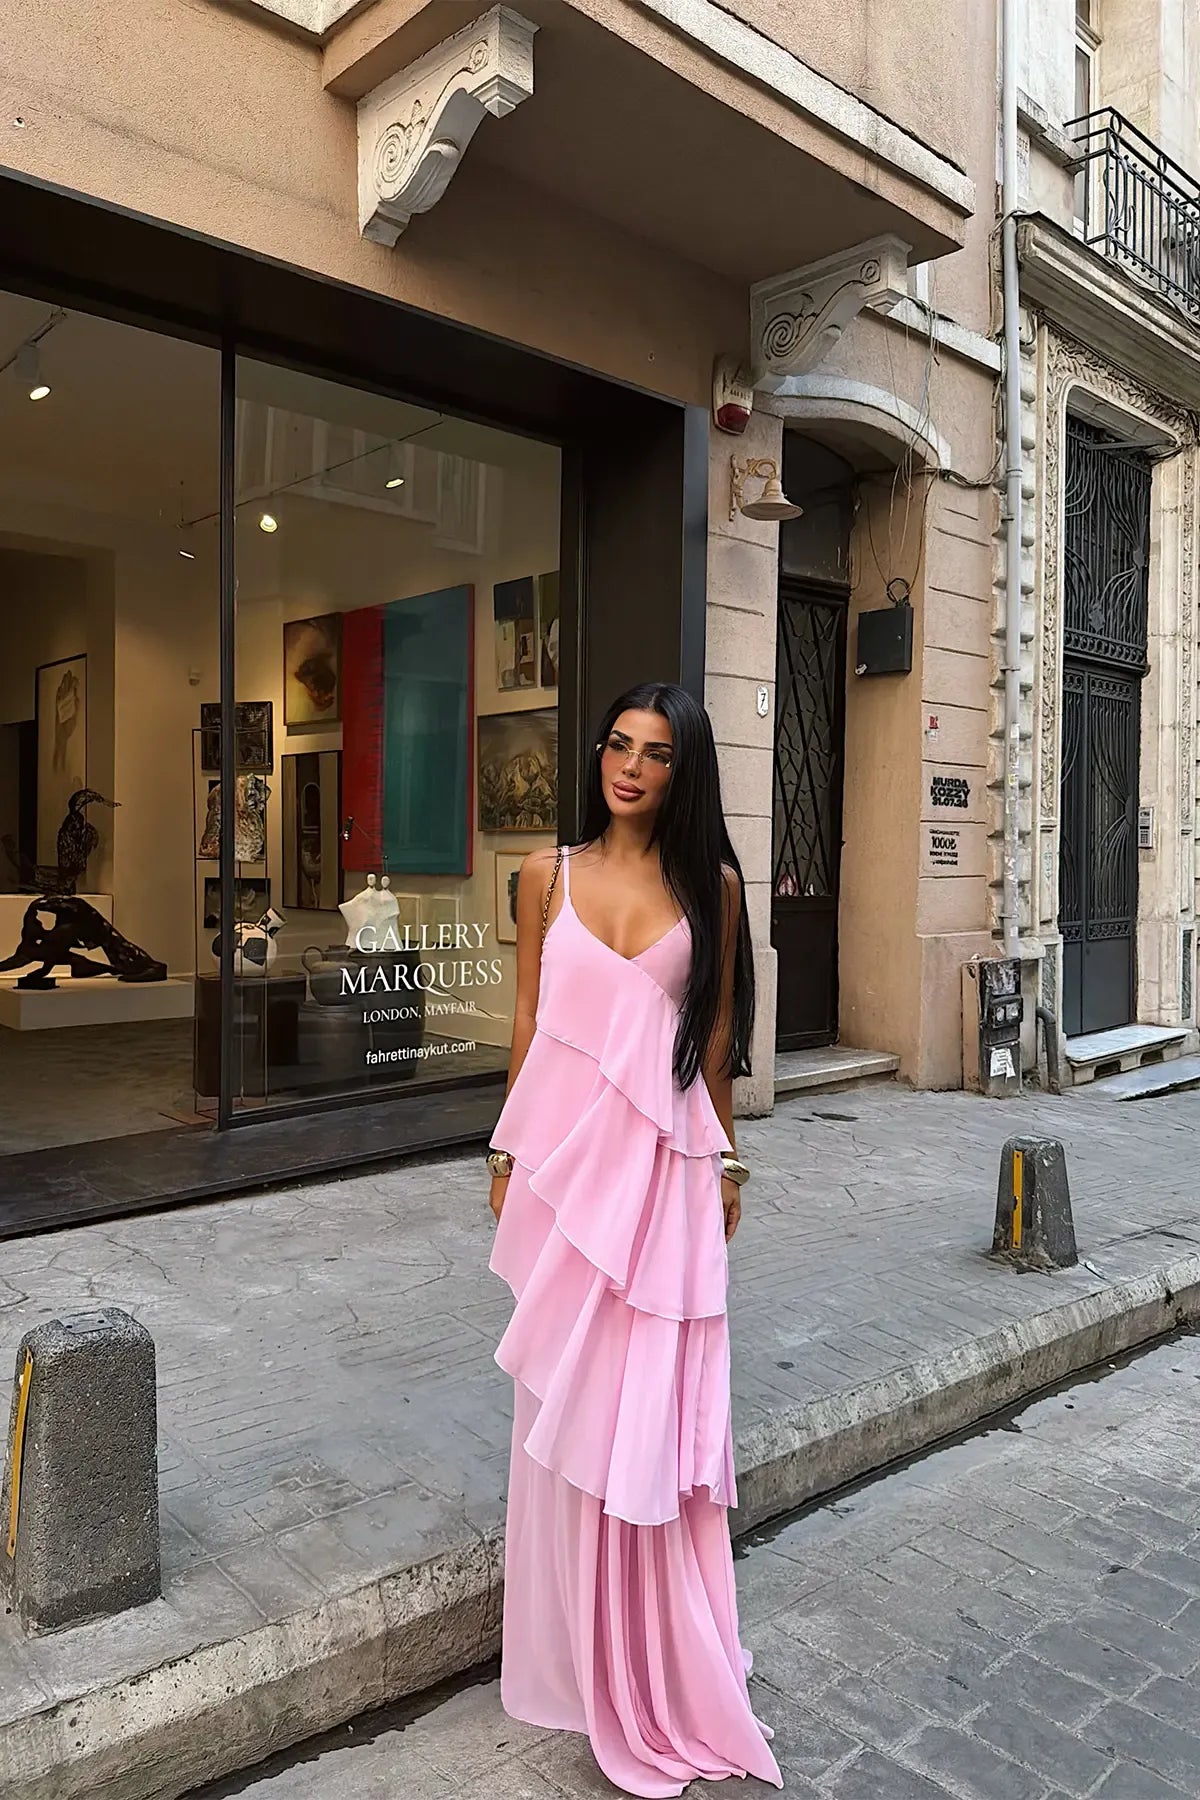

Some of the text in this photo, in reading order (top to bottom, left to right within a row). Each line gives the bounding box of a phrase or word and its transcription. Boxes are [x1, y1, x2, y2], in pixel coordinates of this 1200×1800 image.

[760, 692, 767, 709] 7
[930, 785, 971, 800] KOZZY
[932, 776, 969, 789] MURDA
[355, 923, 490, 954] GALLERY
[339, 959, 503, 996] MARQUESS
[363, 1000, 477, 1024] LONDON, MAYFAIR
[365, 1040, 476, 1065] fahrettinaykut.com
